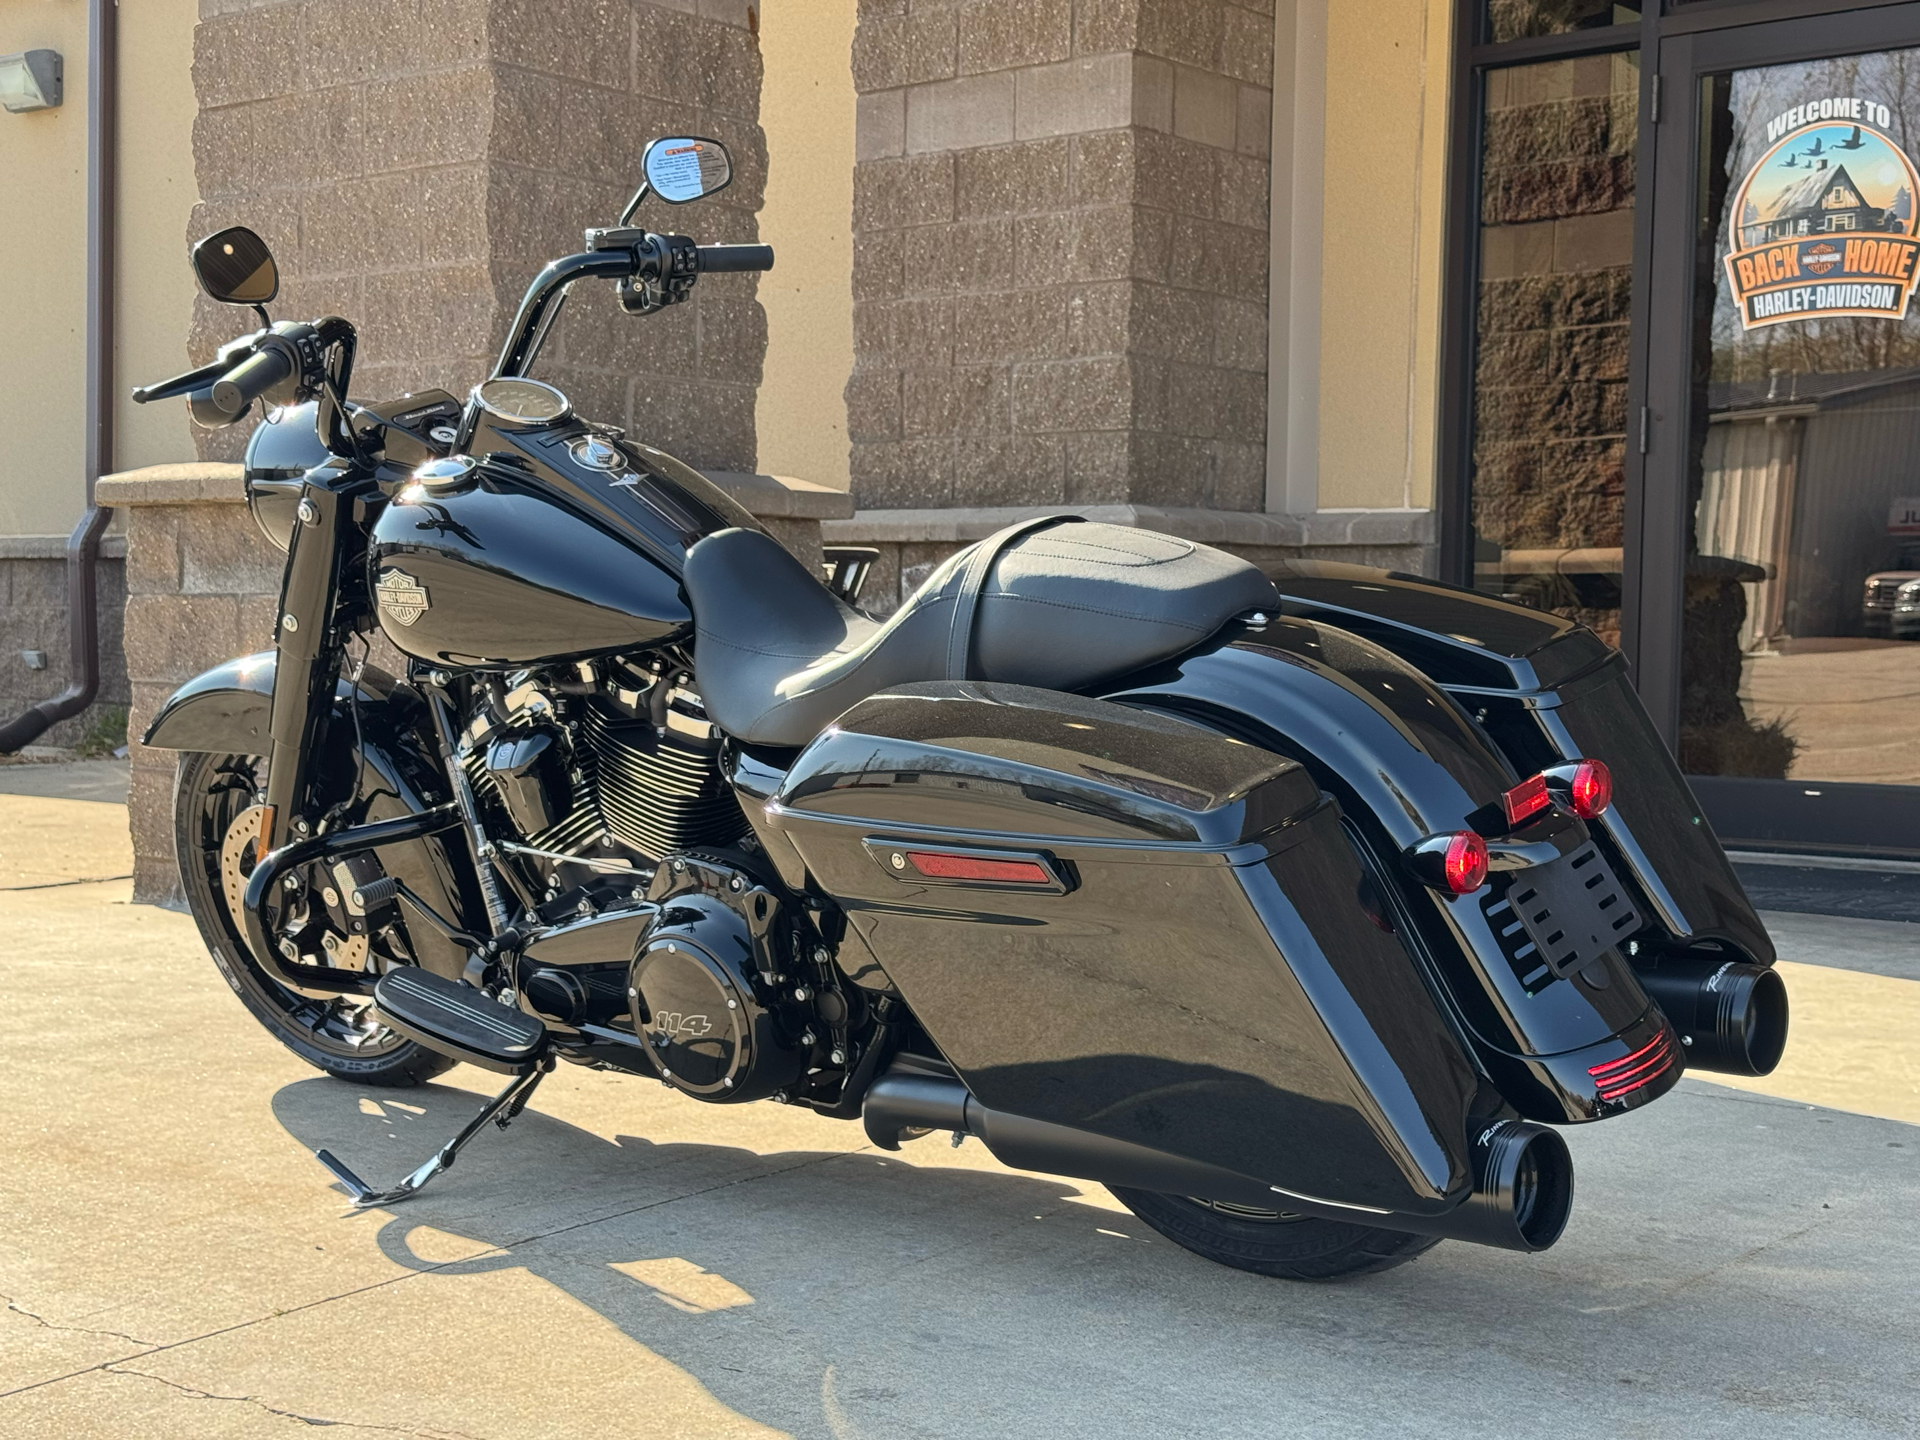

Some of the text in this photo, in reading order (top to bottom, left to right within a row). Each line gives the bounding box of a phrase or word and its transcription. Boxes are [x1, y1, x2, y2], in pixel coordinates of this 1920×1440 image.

[1766, 97, 1890, 142] WELCOME TO
[1736, 239, 1916, 290] BACK HOME
[384, 578, 411, 589] MOTOR
[389, 606, 415, 620] CYCLES
[656, 1010, 712, 1036] 114
